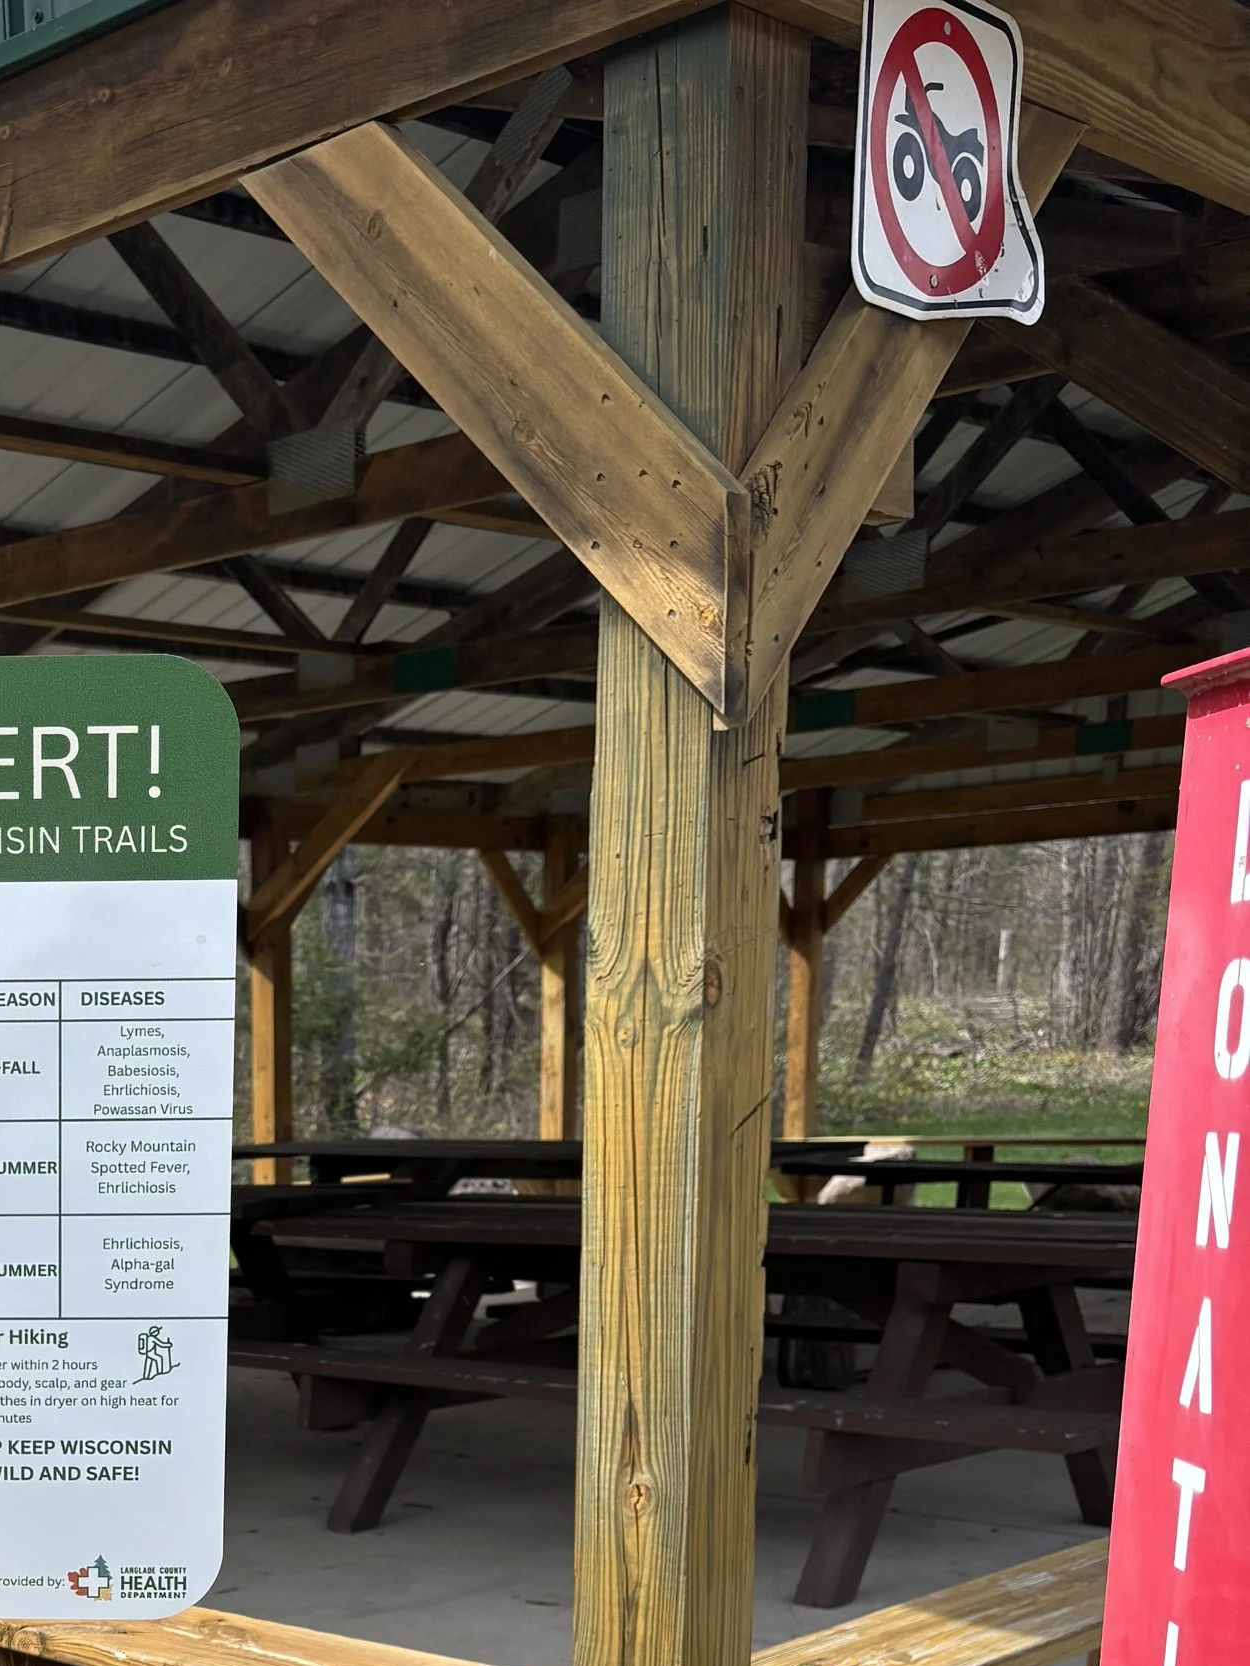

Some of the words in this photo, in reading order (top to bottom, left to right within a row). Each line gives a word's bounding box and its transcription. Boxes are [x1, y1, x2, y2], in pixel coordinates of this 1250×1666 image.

[71, 824, 188, 854] TRAILS
[80, 990, 165, 1007] DISEASES
[120, 1025, 165, 1041] Lymes,
[96, 1043, 191, 1060] Anaplasmosis,
[107, 1064, 180, 1079] Babesiosis,
[103, 1083, 181, 1098] Ehrlichiosis,
[93, 1103, 157, 1116] Powassan
[160, 1103, 194, 1115] Virus
[85, 1139, 127, 1156] Rocky
[130, 1139, 196, 1153] Mountain
[90, 1160, 146, 1177] Spotted
[150, 1161, 191, 1176] Fever,
[98, 1180, 177, 1194] Ehrlichiosis
[102, 1236, 184, 1252] Ehrlichiosis,
[110, 1257, 175, 1274] Alpha-gal
[104, 1277, 174, 1294] Syndrome
[9, 1328, 69, 1349] Hiking
[10, 1359, 49, 1371] within
[51, 1359, 60, 1371] 2
[62, 1359, 98, 1371] hours
[34, 1377, 71, 1392] scalp,
[73, 1377, 97, 1389] and
[100, 1379, 128, 1392] gear
[30, 1394, 42, 1407] in
[44, 1395, 79, 1410] dryer
[80, 1397, 97, 1407] on
[100, 1394, 127, 1410] high
[129, 1395, 158, 1407] heat
[160, 1394, 180, 1407] for
[7, 1439, 56, 1455] KEEP
[59, 1439, 172, 1455] WISCONSIN
[38, 1465, 82, 1481] AND
[86, 1465, 139, 1482] SAFE!
[120, 1566, 156, 1575] LANGLADE
[159, 1566, 187, 1575] COUNTY
[47, 1575, 66, 1590] by:
[120, 1575, 187, 1591] HEALTH
[120, 1591, 187, 1599] DEPARTMENT
